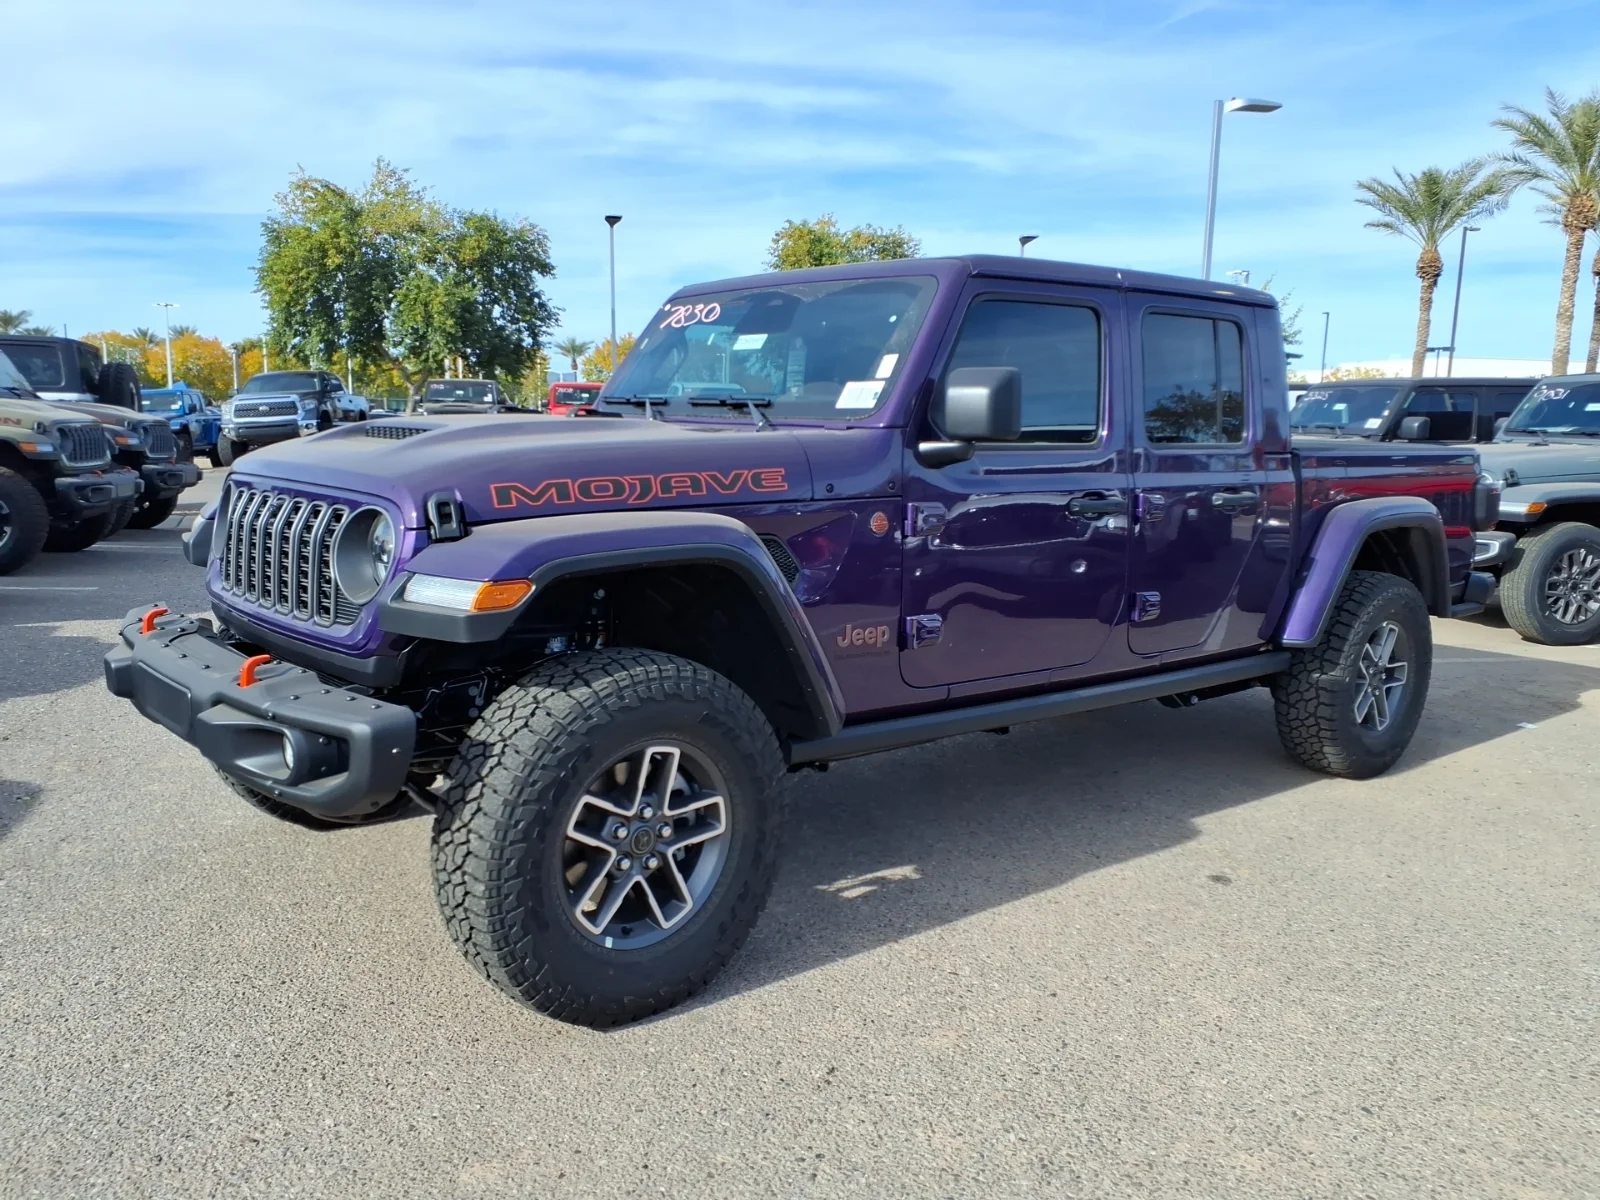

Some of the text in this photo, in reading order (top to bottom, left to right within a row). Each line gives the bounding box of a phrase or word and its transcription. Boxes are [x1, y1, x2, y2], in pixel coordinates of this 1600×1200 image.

[660, 303, 721, 328] 7830
[489, 467, 788, 508] MOJAVE
[836, 624, 890, 648] Jeep
